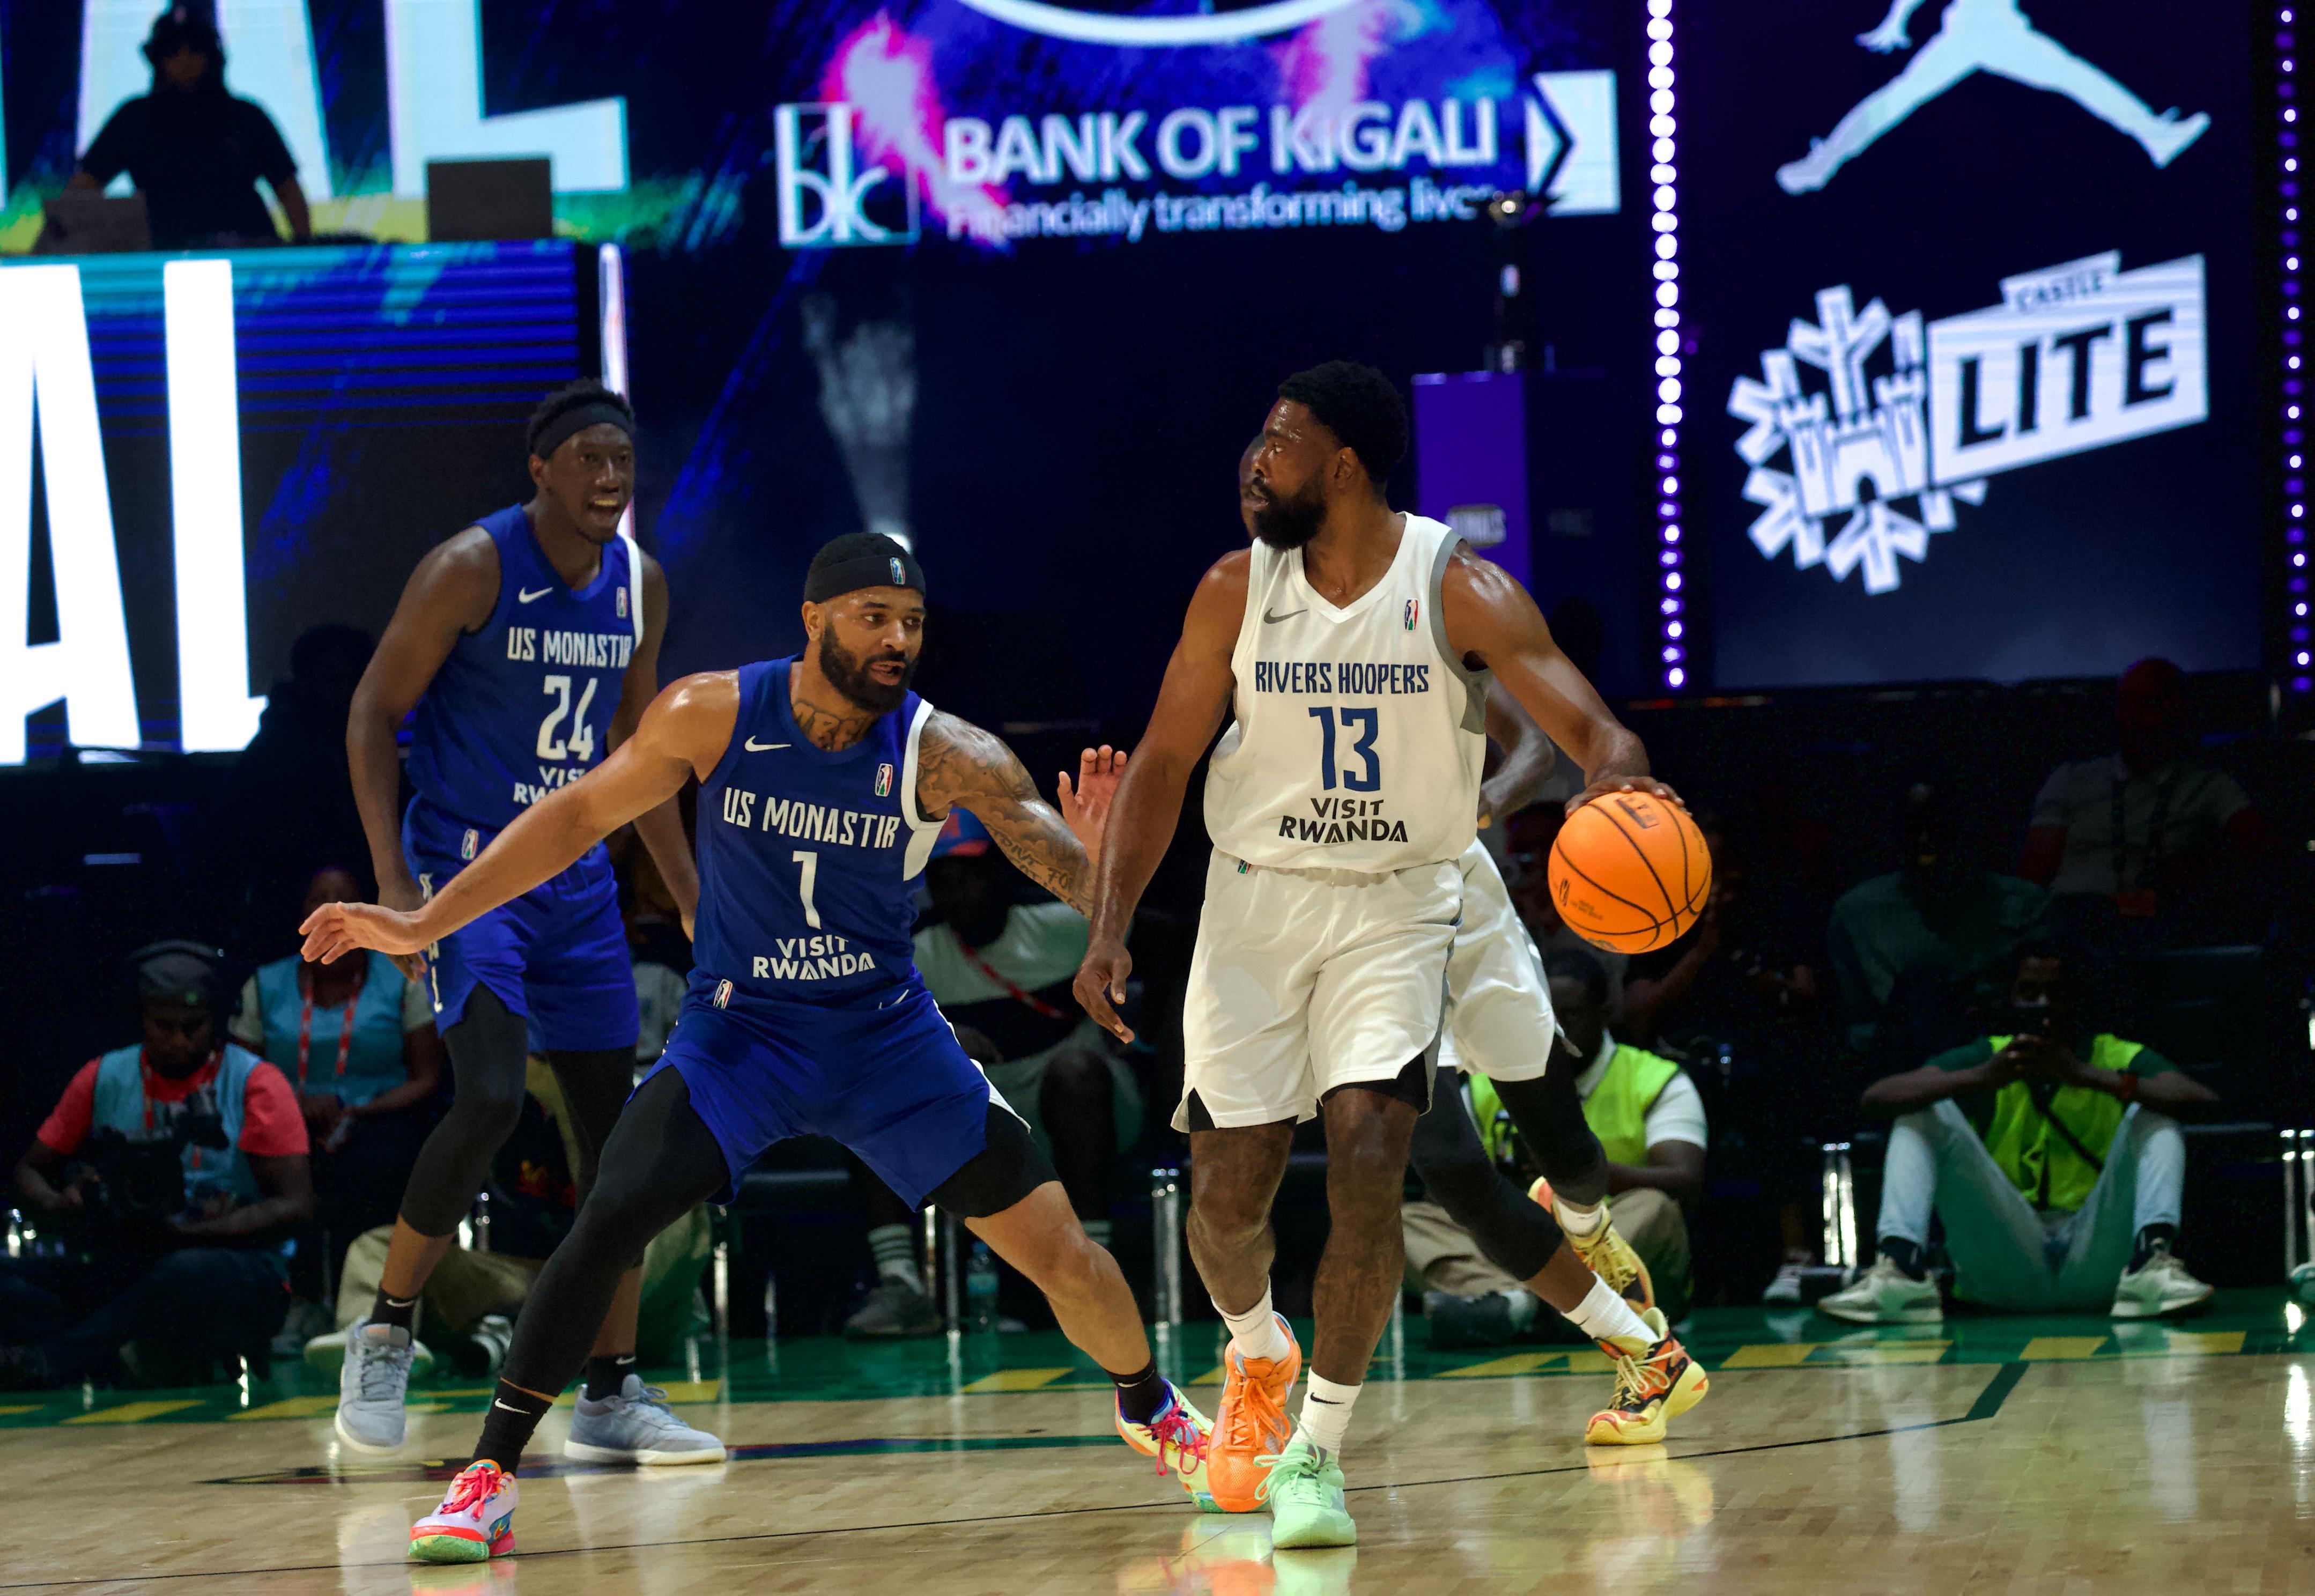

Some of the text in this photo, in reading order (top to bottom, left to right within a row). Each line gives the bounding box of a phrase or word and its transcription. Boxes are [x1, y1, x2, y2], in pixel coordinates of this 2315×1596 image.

[943, 98, 1497, 186] BANK OF KIGALI
[1154, 180, 1407, 232] transforming
[1409, 176, 1499, 222] live
[1959, 308, 2176, 448] LITE
[507, 626, 632, 668] US MONASTIR
[1255, 661, 1429, 694] RIVERS HOOPERS
[537, 675, 598, 761] 24
[1308, 706, 1381, 792] 13
[538, 765, 585, 787] VIS
[724, 787, 901, 848] US MONASTIR
[1278, 816, 1408, 844] RWANDA
[1311, 797, 1384, 819] VISIT
[793, 851, 822, 930] 1
[753, 952, 876, 980] RWANDA
[775, 934, 849, 958] VISIT
